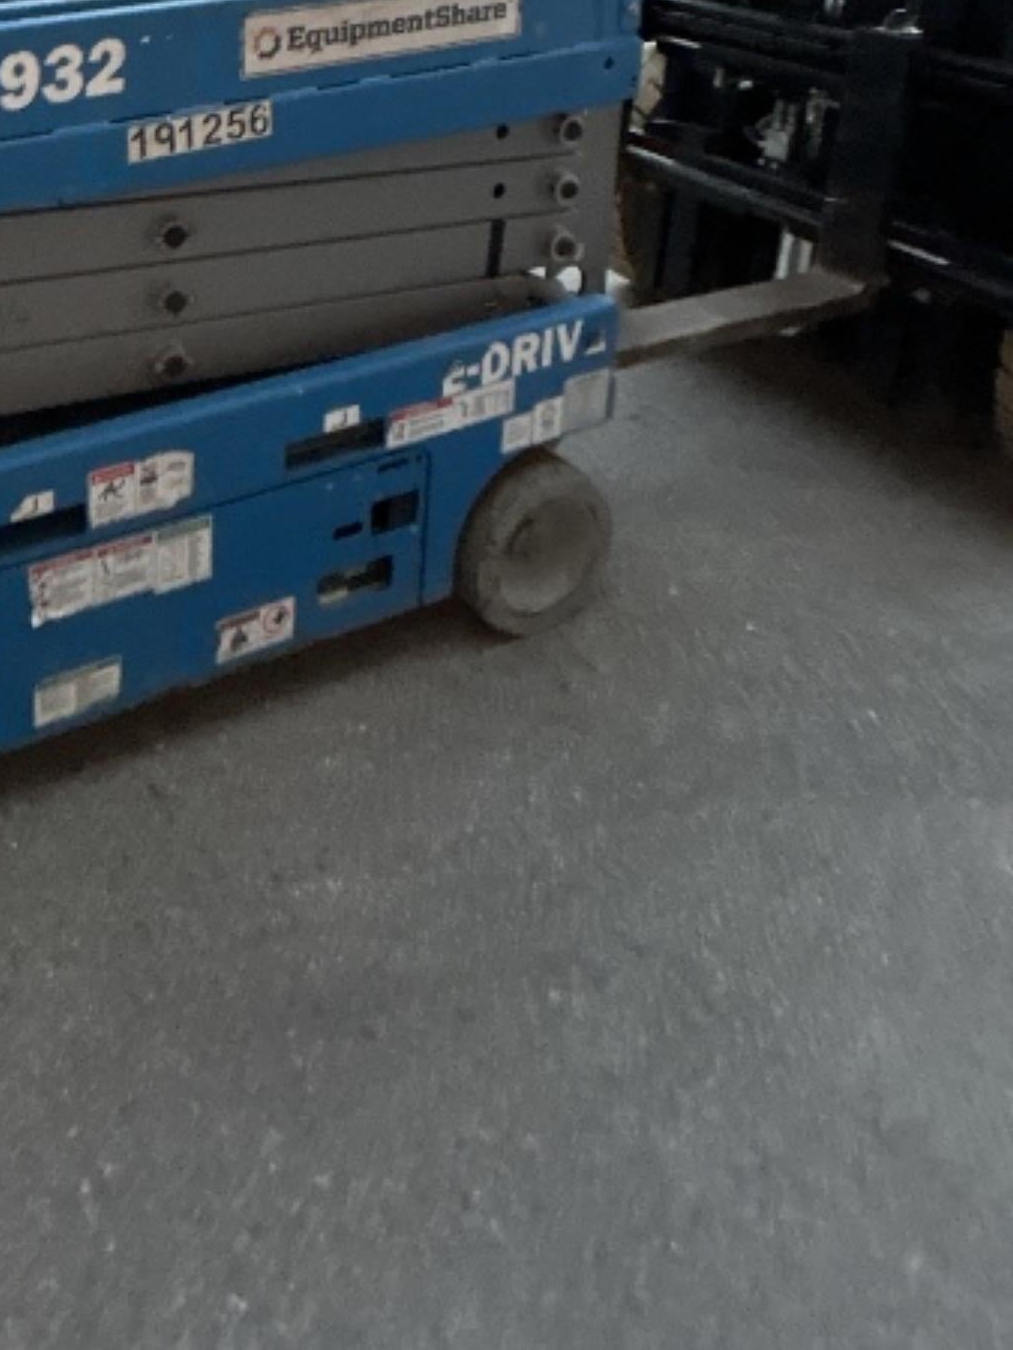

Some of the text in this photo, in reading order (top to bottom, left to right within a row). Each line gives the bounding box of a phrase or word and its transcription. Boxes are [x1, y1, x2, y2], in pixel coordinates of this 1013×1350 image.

[287, 2, 507, 53] EquipmentShare
[130, 104, 268, 160] 191256
[443, 320, 606, 397] E-DRIV
